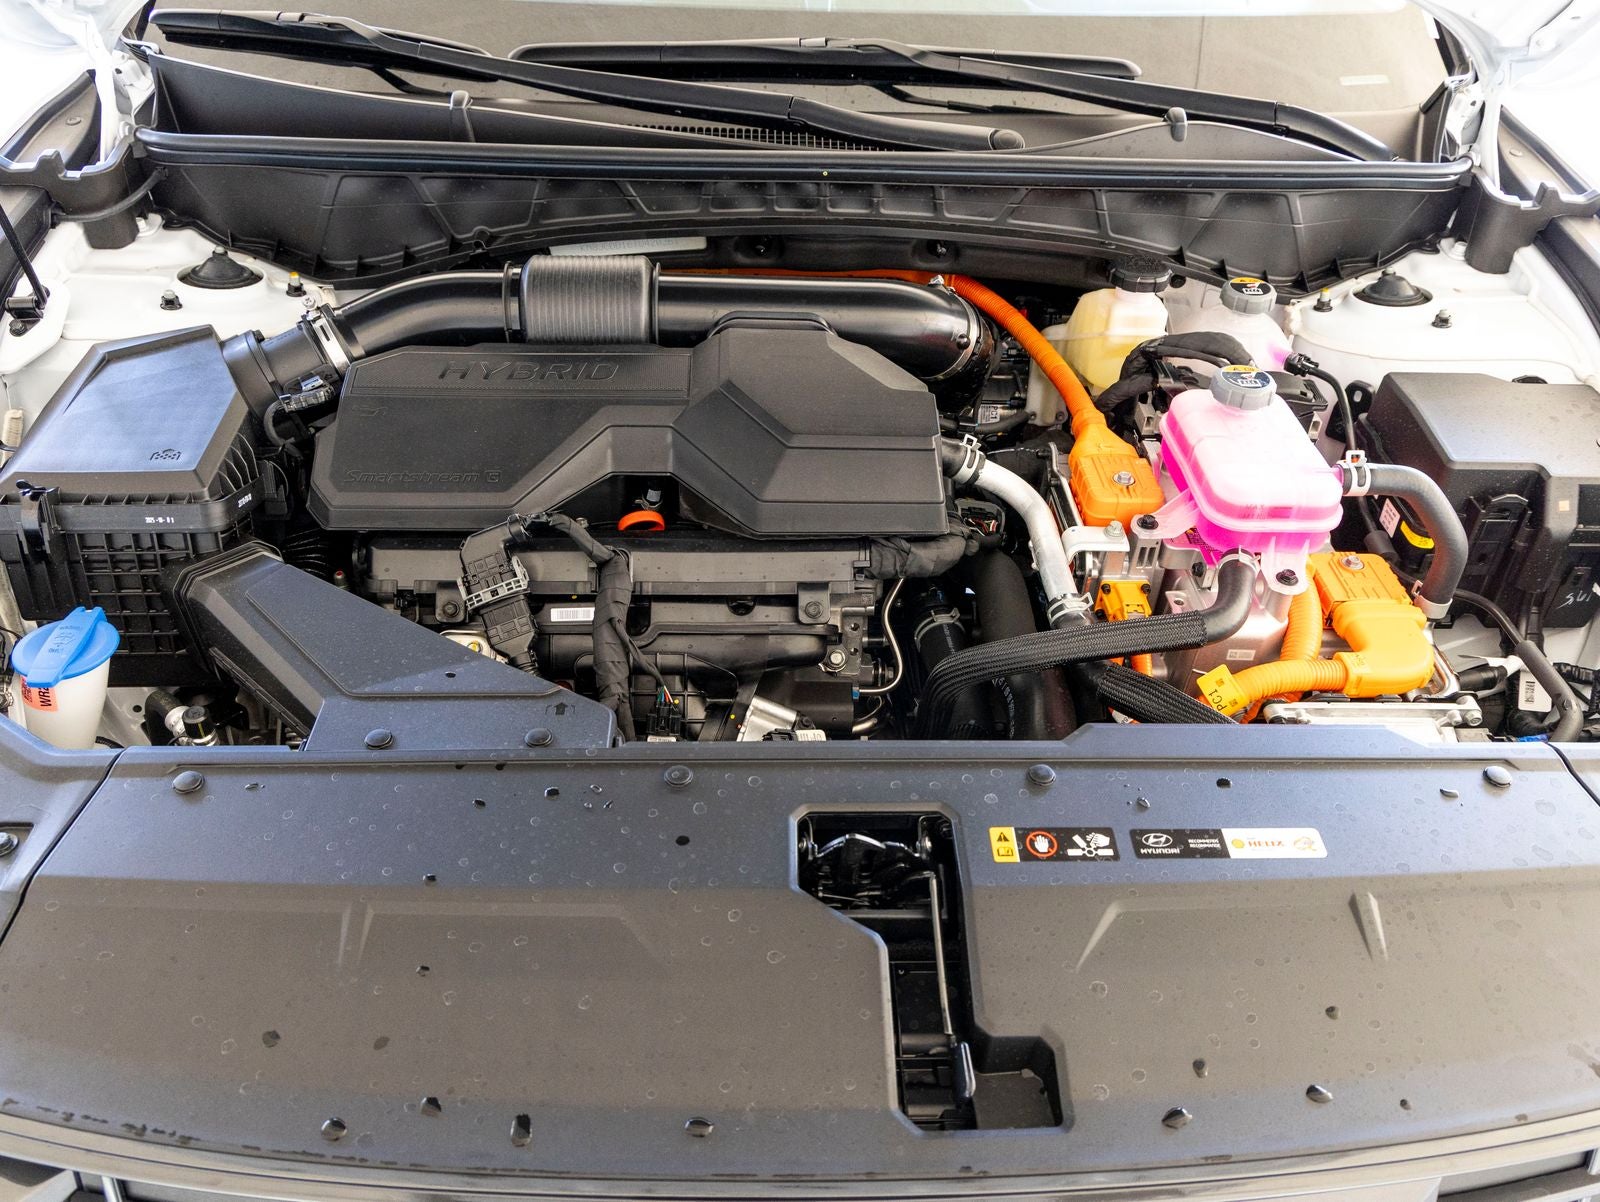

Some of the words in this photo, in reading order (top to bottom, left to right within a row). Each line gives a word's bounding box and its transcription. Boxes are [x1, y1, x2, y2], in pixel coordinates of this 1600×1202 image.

[438, 361, 619, 381] HYBRID
[344, 469, 480, 483] Smartstream
[485, 469, 502, 483] G
[1208, 688, 1228, 711] PC1
[1248, 840, 1285, 848] HELIX
